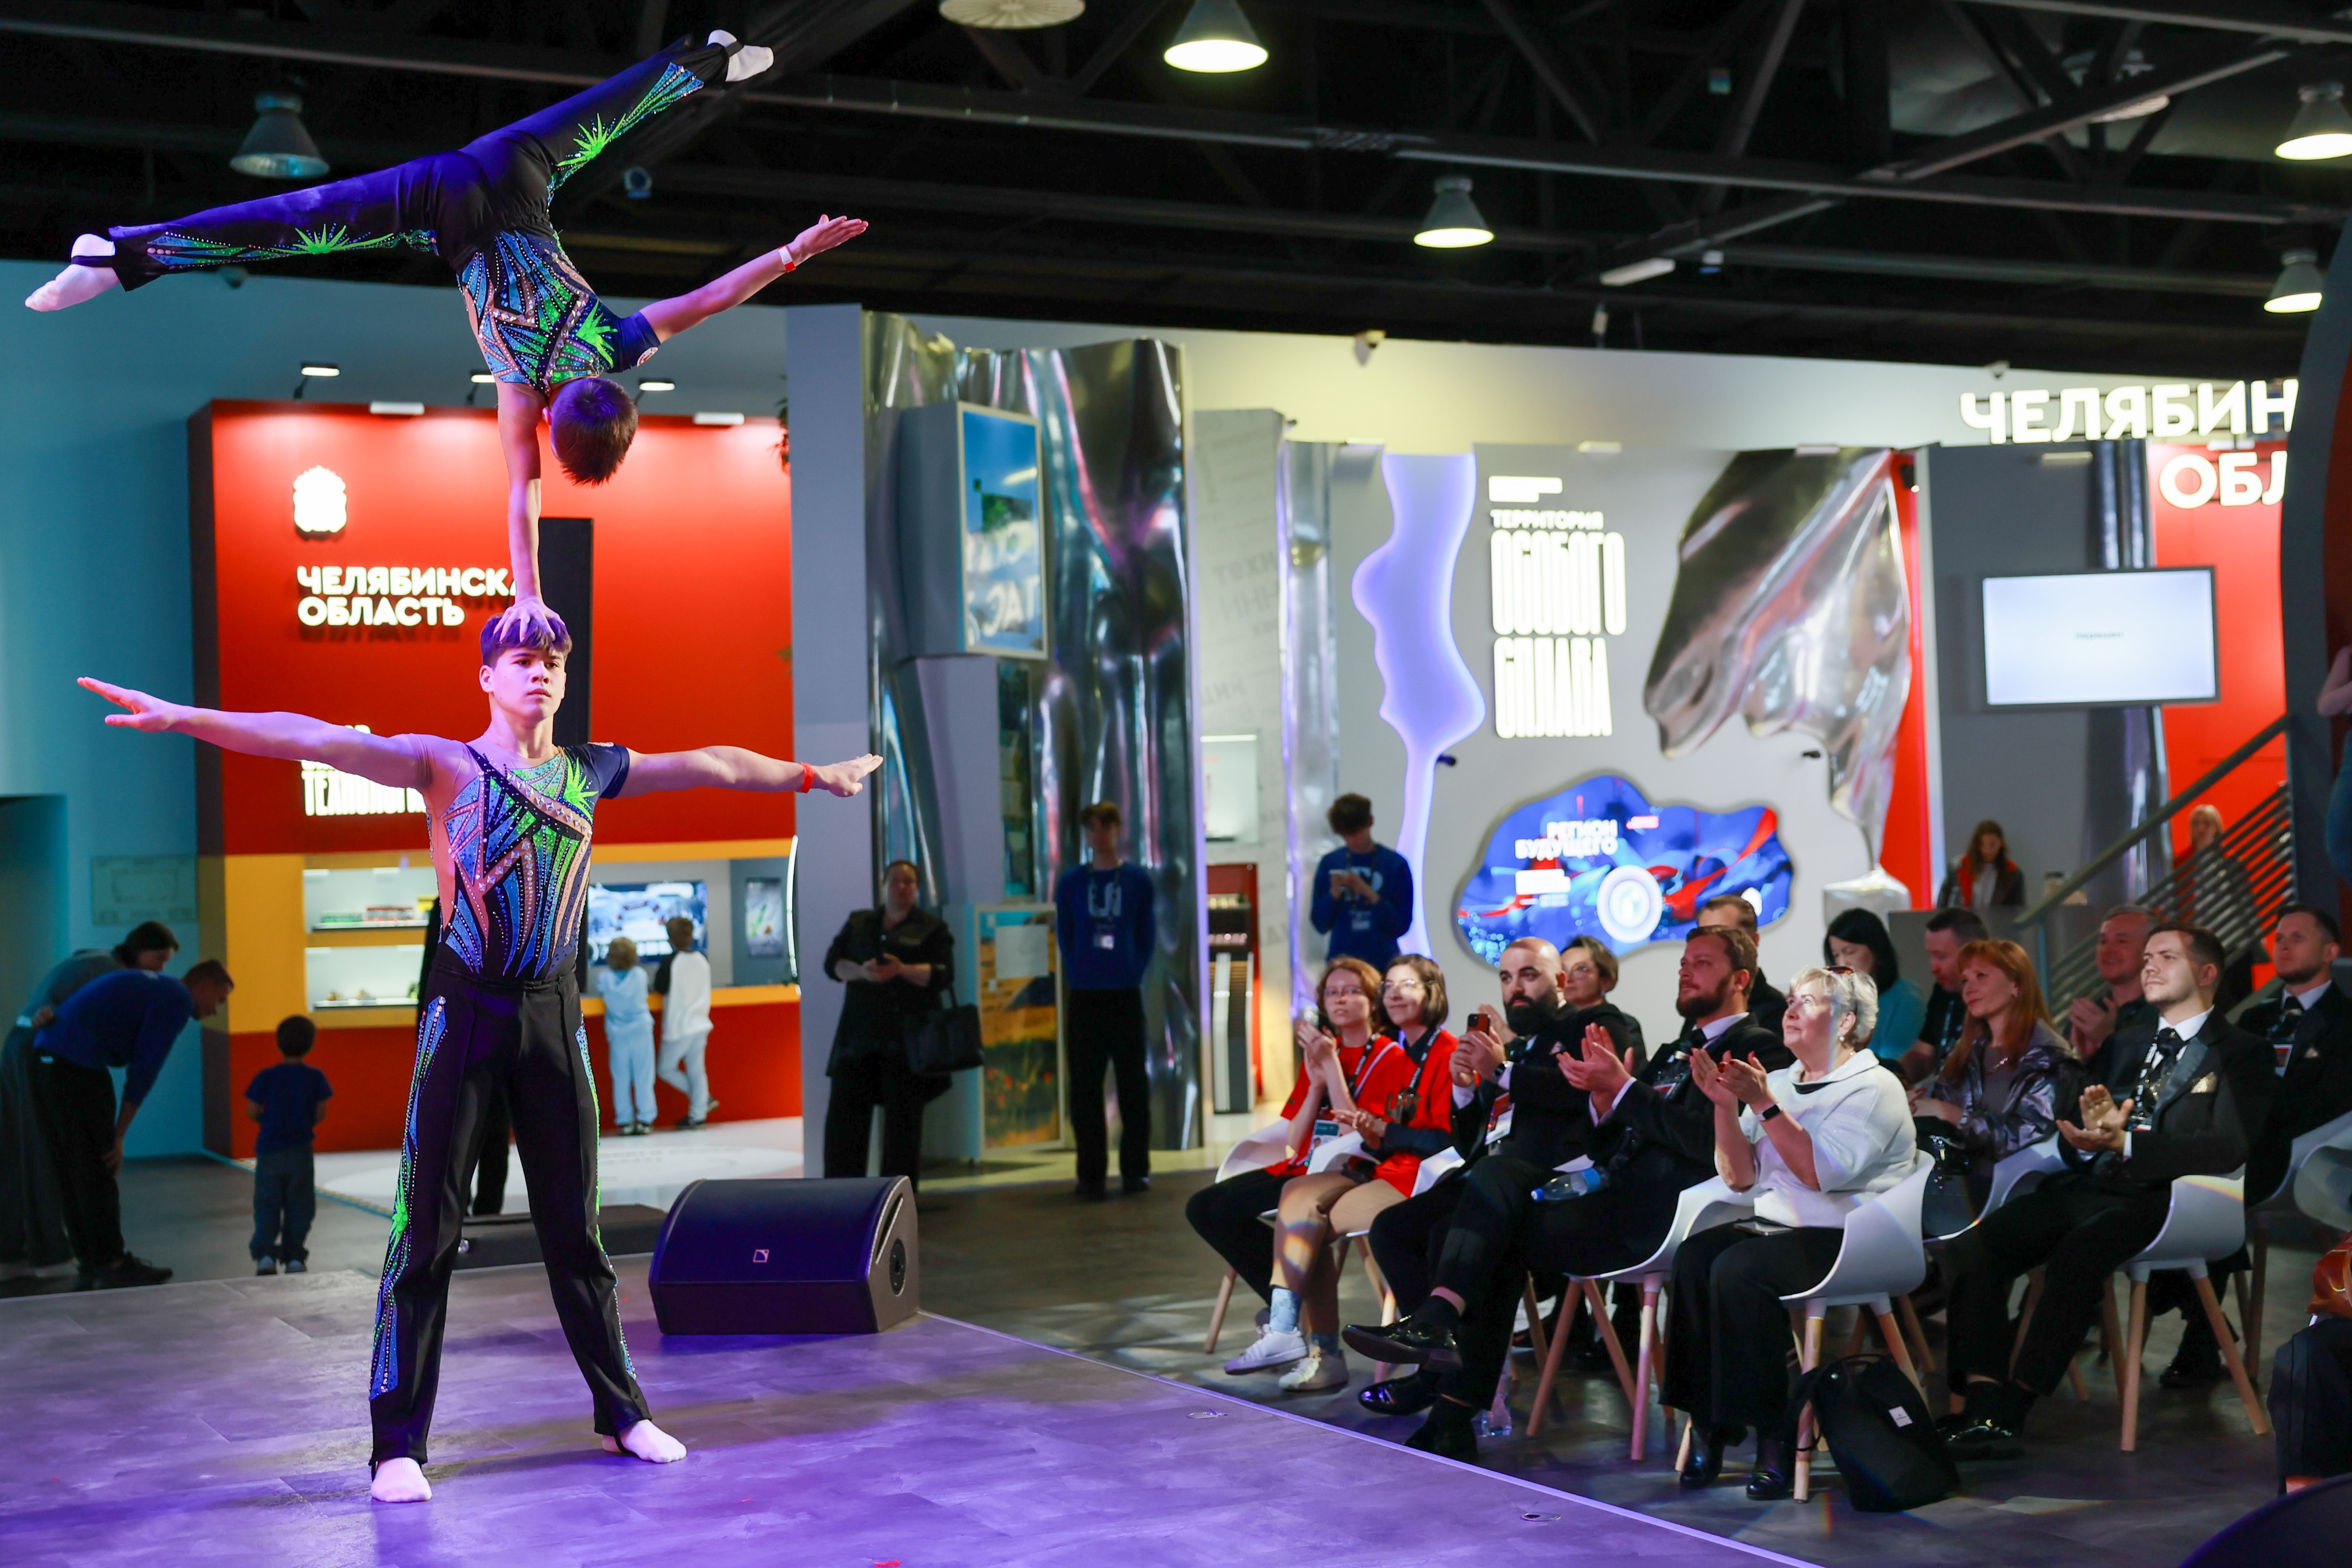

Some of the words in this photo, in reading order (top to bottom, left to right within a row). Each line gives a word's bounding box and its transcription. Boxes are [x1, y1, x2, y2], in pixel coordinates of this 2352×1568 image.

[1960, 378, 2299, 444] ЧЕЛЯБИН
[1490, 509, 1604, 530] ТЕРРИТОРИЯ
[297, 566, 516, 596] ЧЕЛЯБИНСК
[297, 596, 465, 626] ОБЛАСТЬ
[1546, 819, 1618, 840] РЕГИОН
[1515, 836, 1618, 861] БУДУЩЕГО
